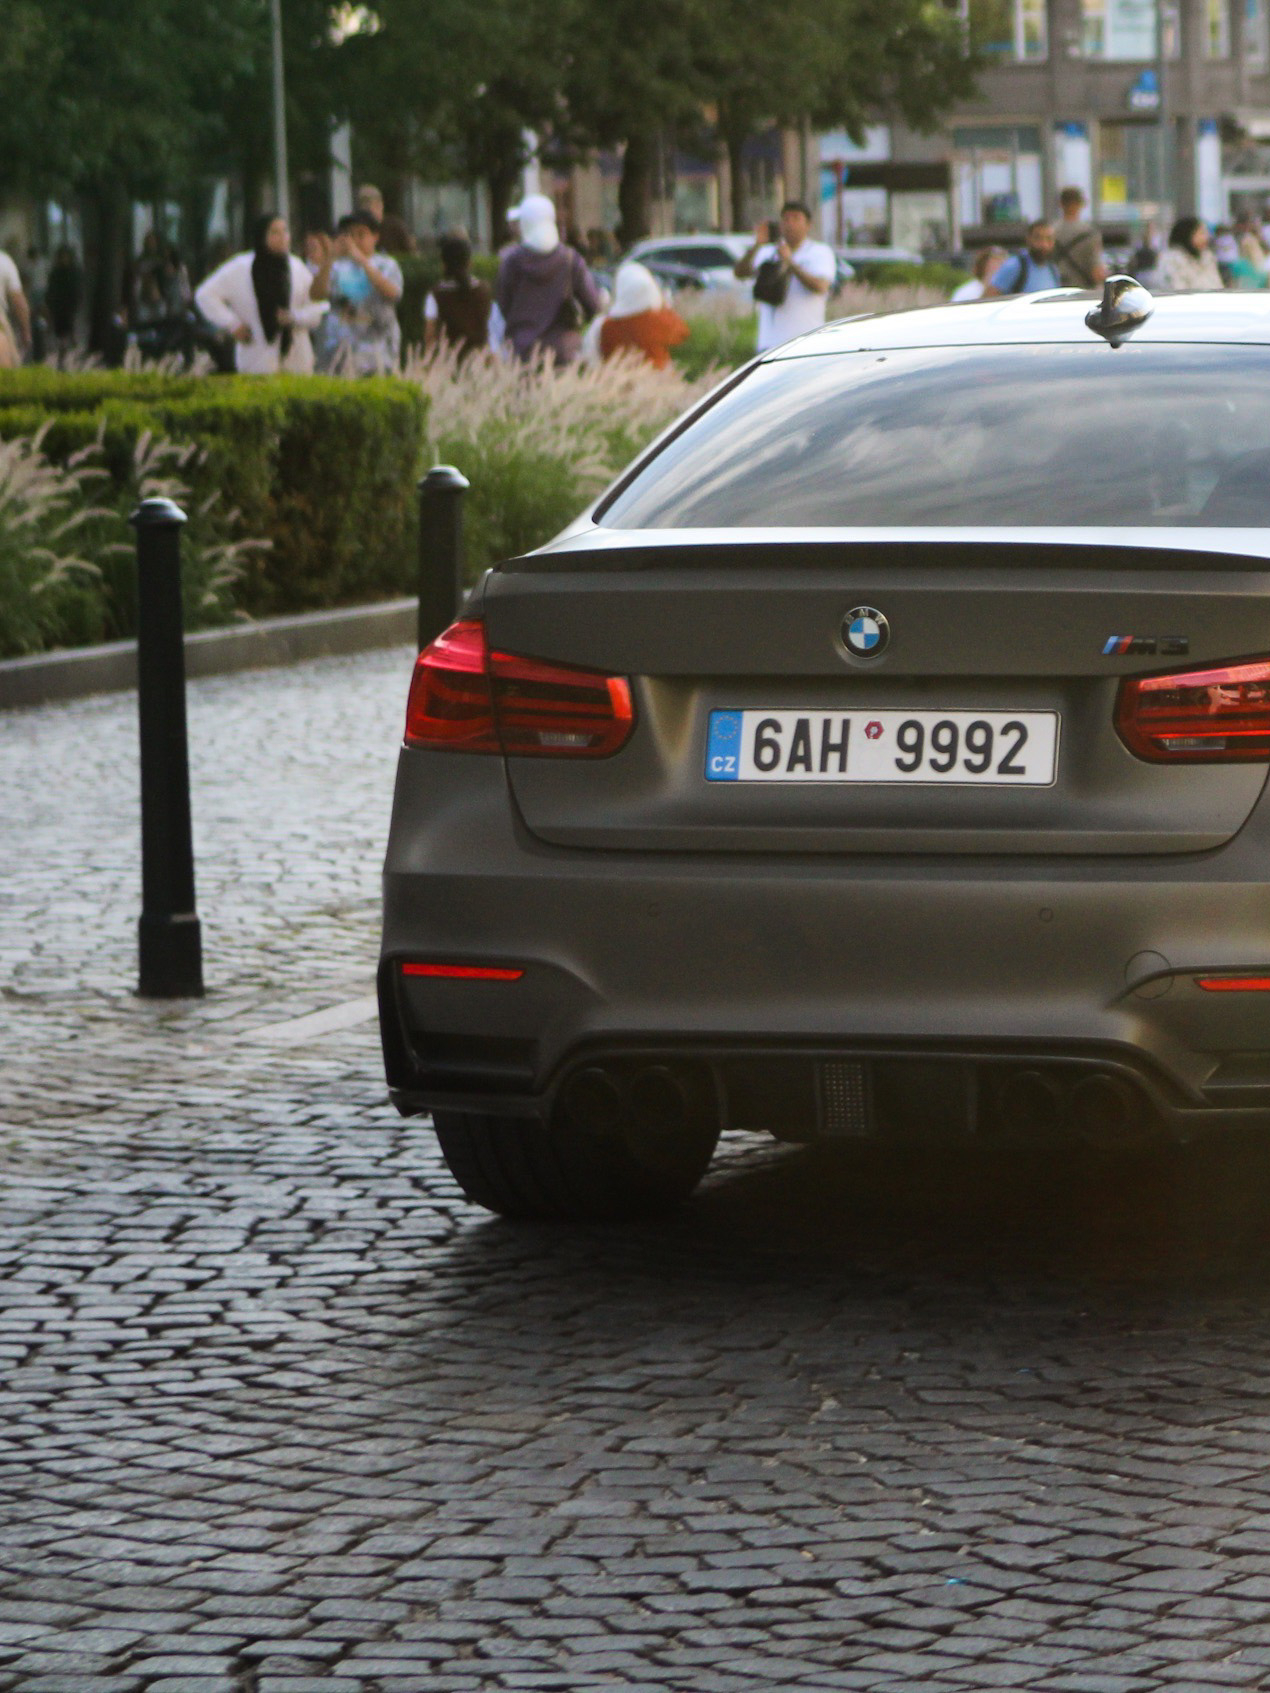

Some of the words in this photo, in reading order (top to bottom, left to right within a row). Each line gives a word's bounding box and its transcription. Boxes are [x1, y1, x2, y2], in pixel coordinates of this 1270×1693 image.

[845, 608, 887, 625] BMW
[1127, 635, 1189, 655] M3
[752, 717, 852, 773] 6AH
[894, 719, 1029, 776] 9992
[711, 757, 736, 773] CZ
